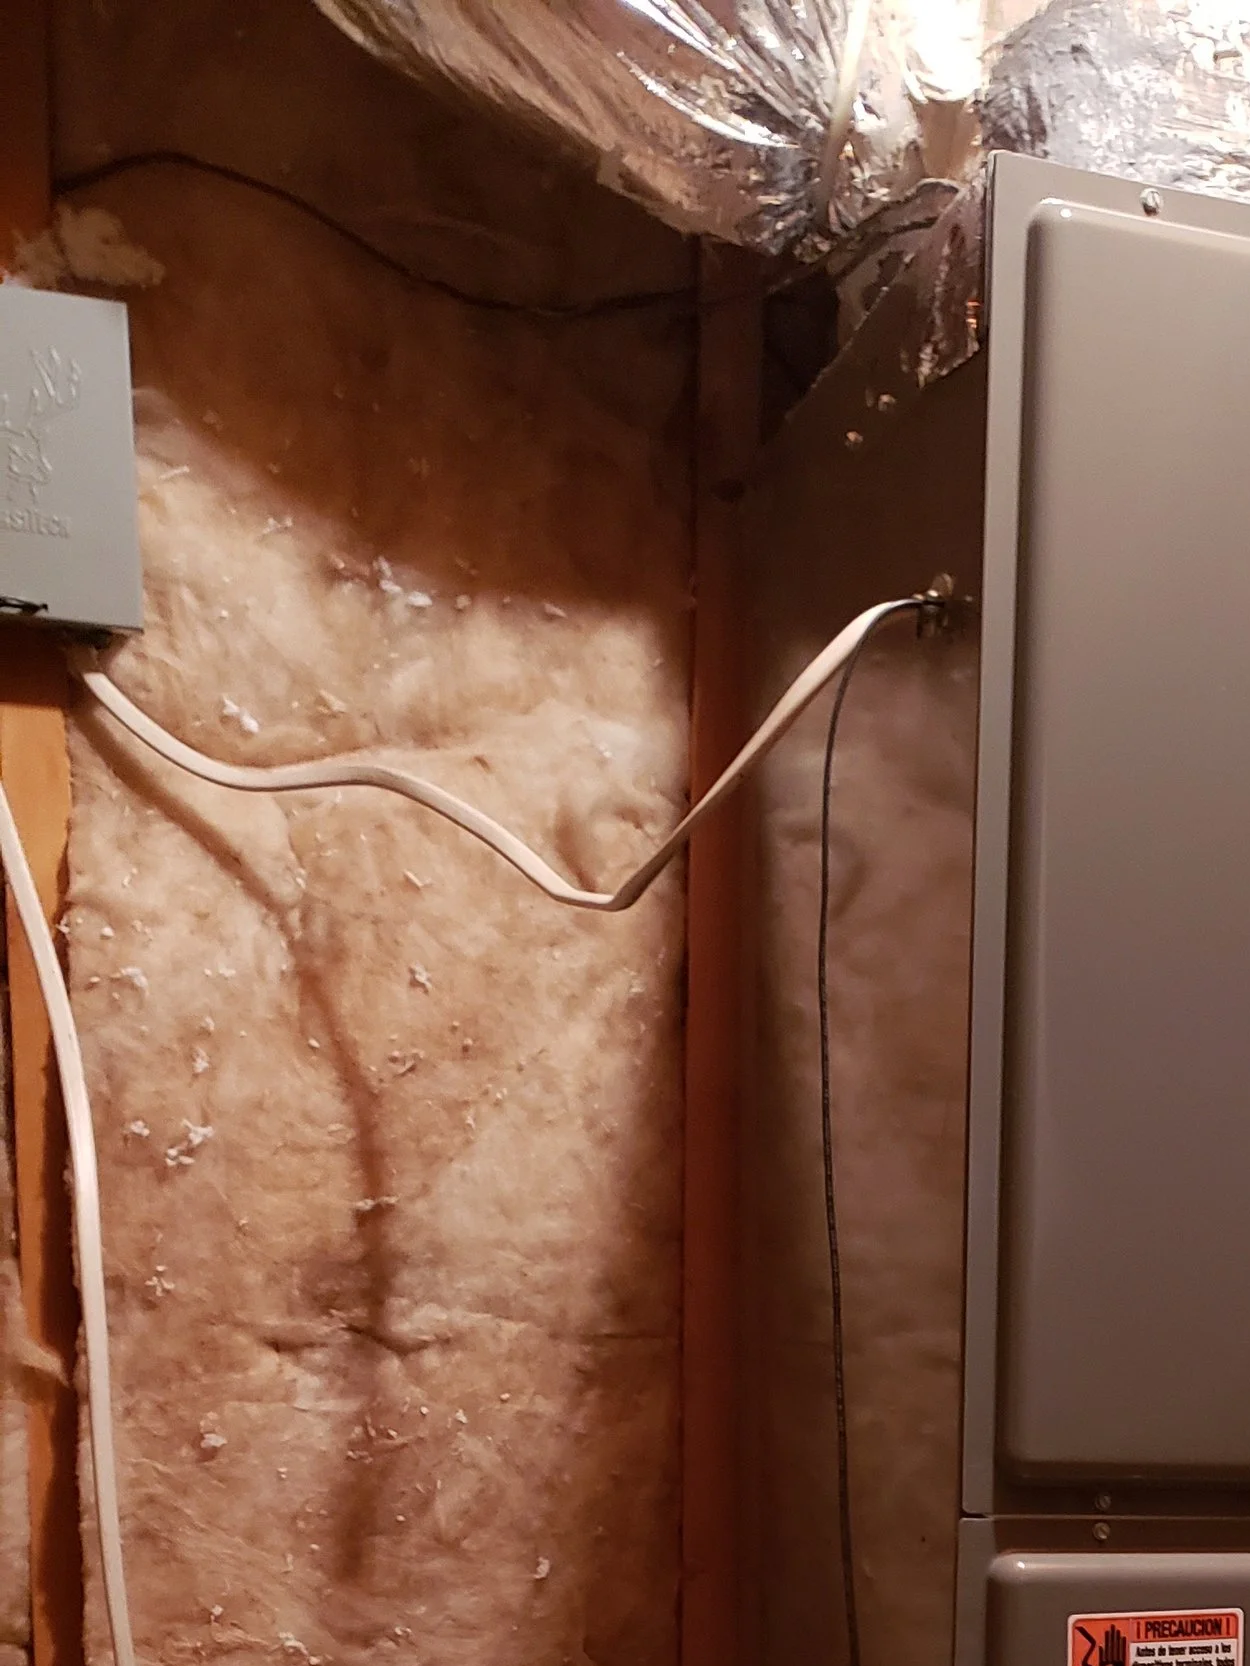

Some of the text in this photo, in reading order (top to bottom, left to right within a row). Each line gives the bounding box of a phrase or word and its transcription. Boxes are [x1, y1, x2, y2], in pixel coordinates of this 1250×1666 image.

[1145, 1618, 1222, 1639] PRECAUCION
[1136, 1646, 1155, 1657] Antes
[1158, 1646, 1166, 1656] de
[1189, 1646, 1213, 1655] acceso
[1221, 1642, 1231, 1653] los
